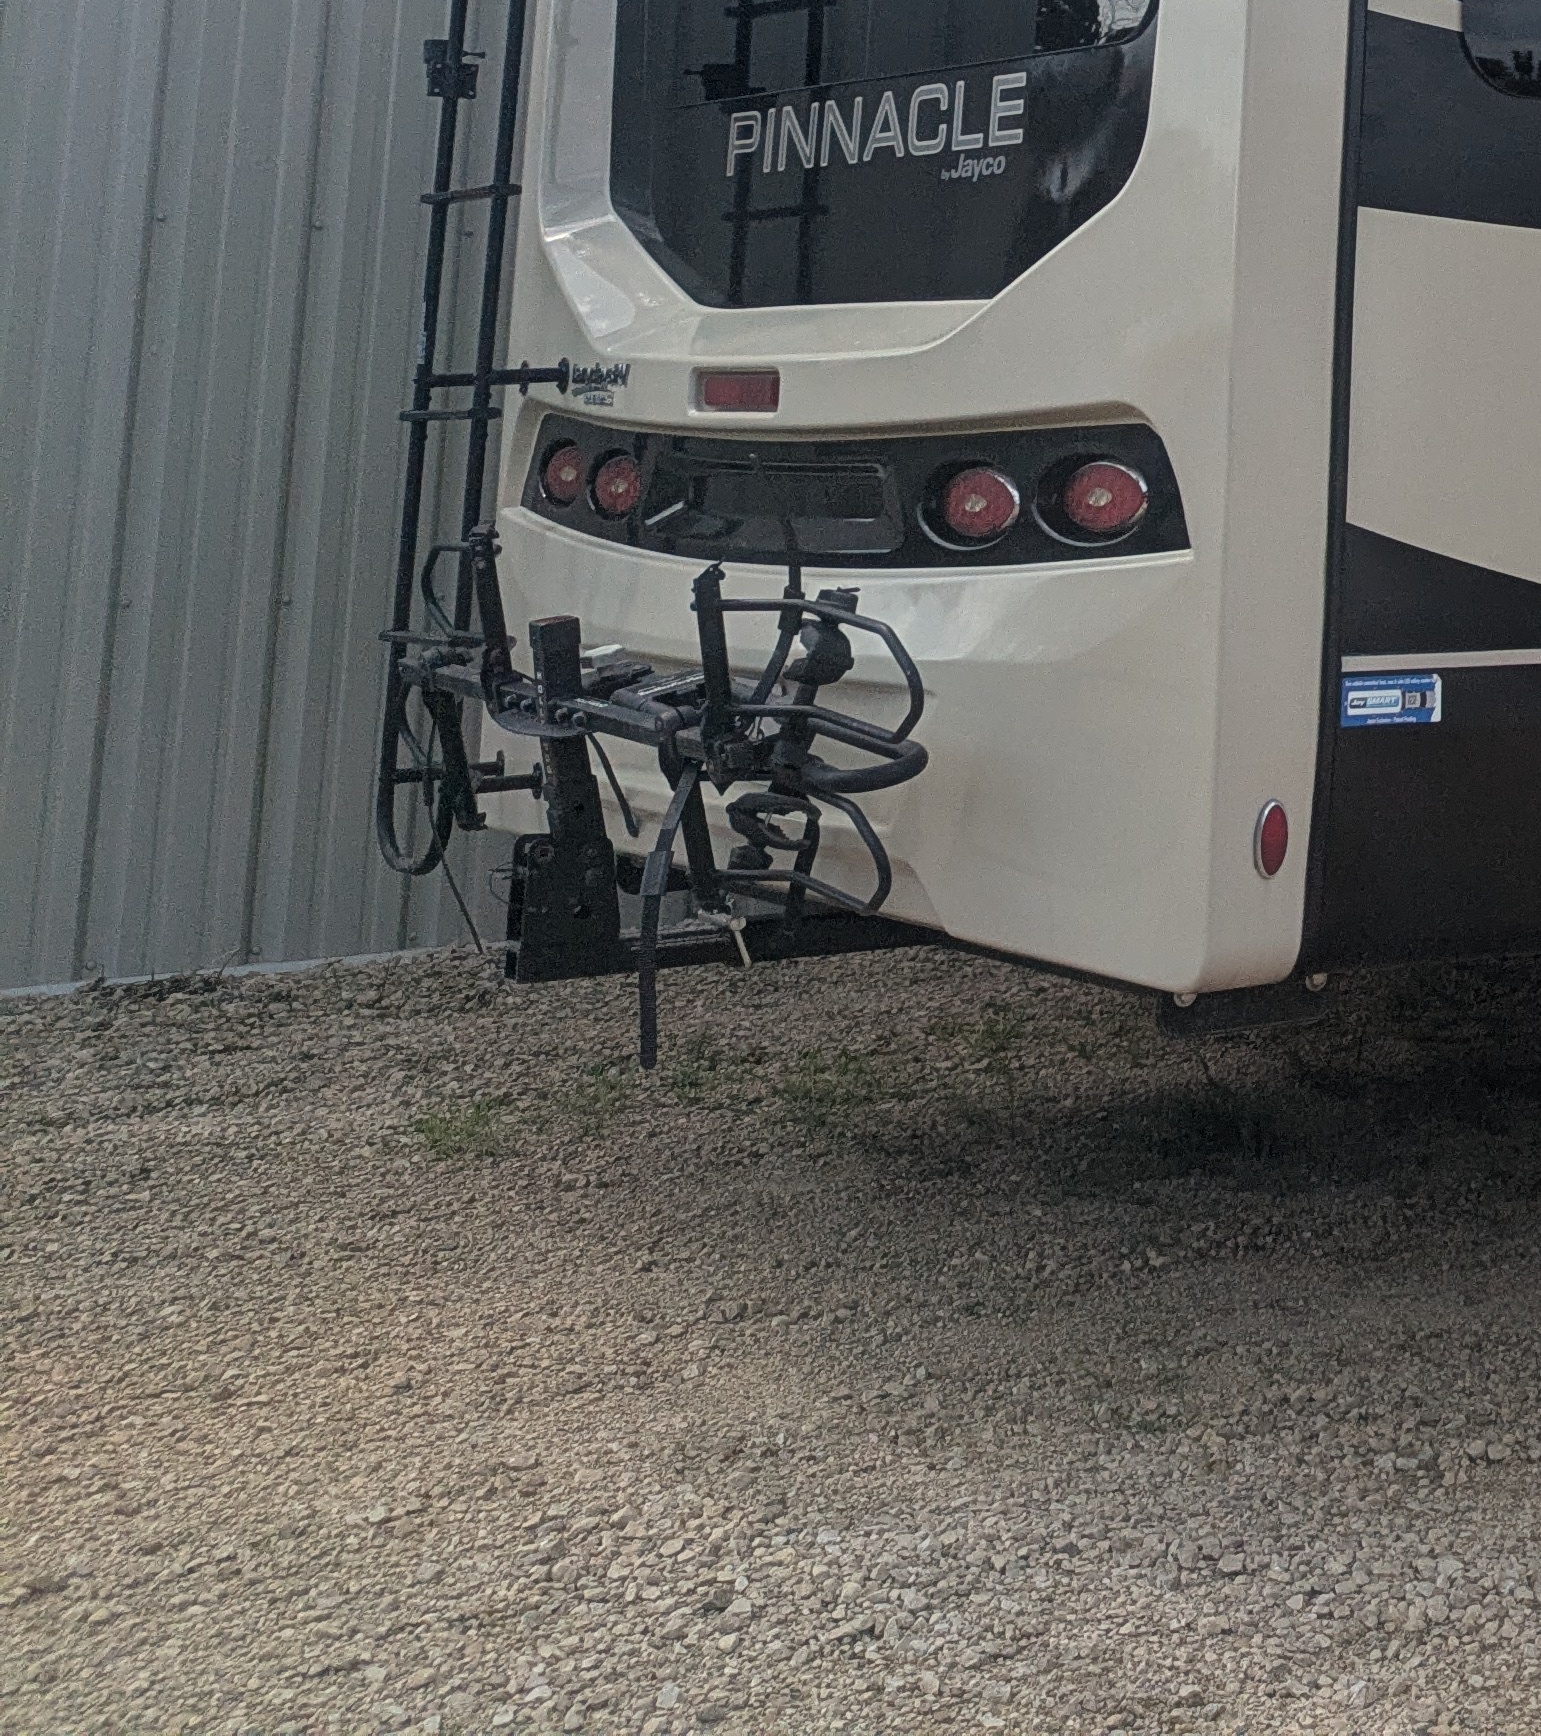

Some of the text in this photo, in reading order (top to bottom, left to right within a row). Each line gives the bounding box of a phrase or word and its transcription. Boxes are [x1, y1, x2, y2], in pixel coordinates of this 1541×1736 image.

[726, 71, 1027, 177] PINNACLE
[951, 153, 1006, 183] Jayco
[1366, 695, 1398, 706] SMART
